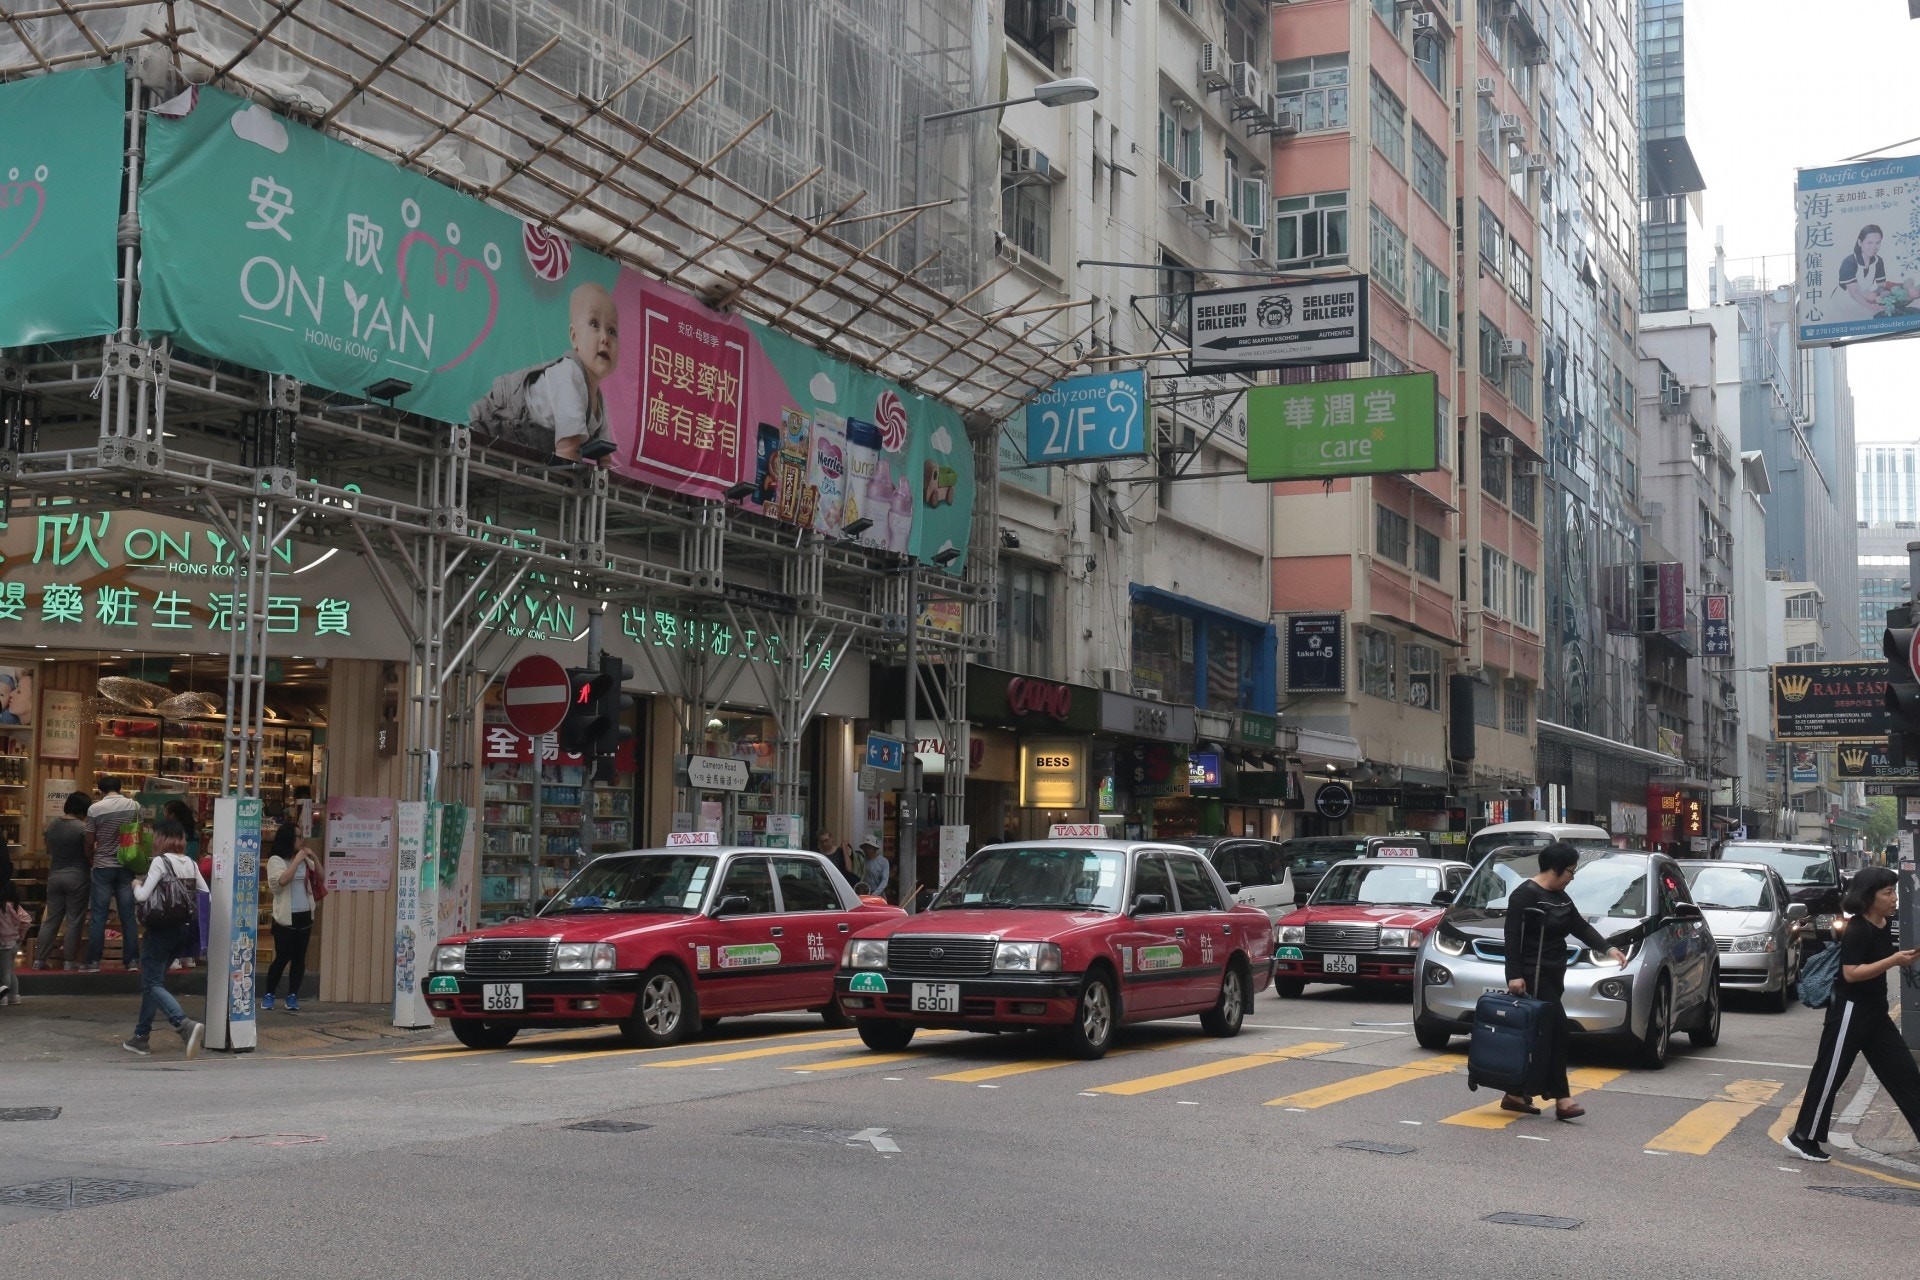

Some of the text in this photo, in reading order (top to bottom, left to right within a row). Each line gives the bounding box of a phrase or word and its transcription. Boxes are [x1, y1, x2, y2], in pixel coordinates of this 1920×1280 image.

[1815, 164, 1904, 185] Pacific Garden
[246, 175, 384, 275] 安欣
[239, 255, 435, 361] ON YAN
[1302, 305, 1354, 322] GALLERY
[1197, 316, 1247, 331] GALLERY
[1318, 329, 1352, 338] AUTHENTIC
[304, 326, 379, 364] HONG KONG
[1283, 389, 1396, 430] 華潤堂
[647, 395, 737, 459] 應有盡有
[1042, 407, 1096, 455] 2/F
[817, 451, 844, 475] Merries
[0, 499, 110, 569] 欣
[124, 528, 191, 563] ON
[168, 562, 248, 578] HONG KONG
[1706, 640, 1729, 652] 會計
[1813, 683, 1852, 696] RAJA
[702, 760, 737, 772] Cameron Road
[1036, 757, 1070, 767] BESS
[1870, 754, 1890, 764] RA
[706, 774, 732, 786] 金馬倫道
[1054, 825, 1100, 836] TAXI
[671, 832, 710, 844] TAXI
[1381, 848, 1414, 856] TAXI
[807, 932, 824, 946] 的士
[1200, 933, 1212, 948] 的士
[807, 946, 824, 962] TAXI
[1200, 948, 1214, 964] TAXI
[1334, 955, 1347, 964] JX
[1326, 964, 1355, 972] 8550
[440, 978, 446, 987] 4
[864, 976, 872, 985] 4
[494, 984, 511, 996] UX
[926, 984, 946, 996] TF
[488, 995, 519, 1010] 5687
[917, 997, 954, 1011] 6301
